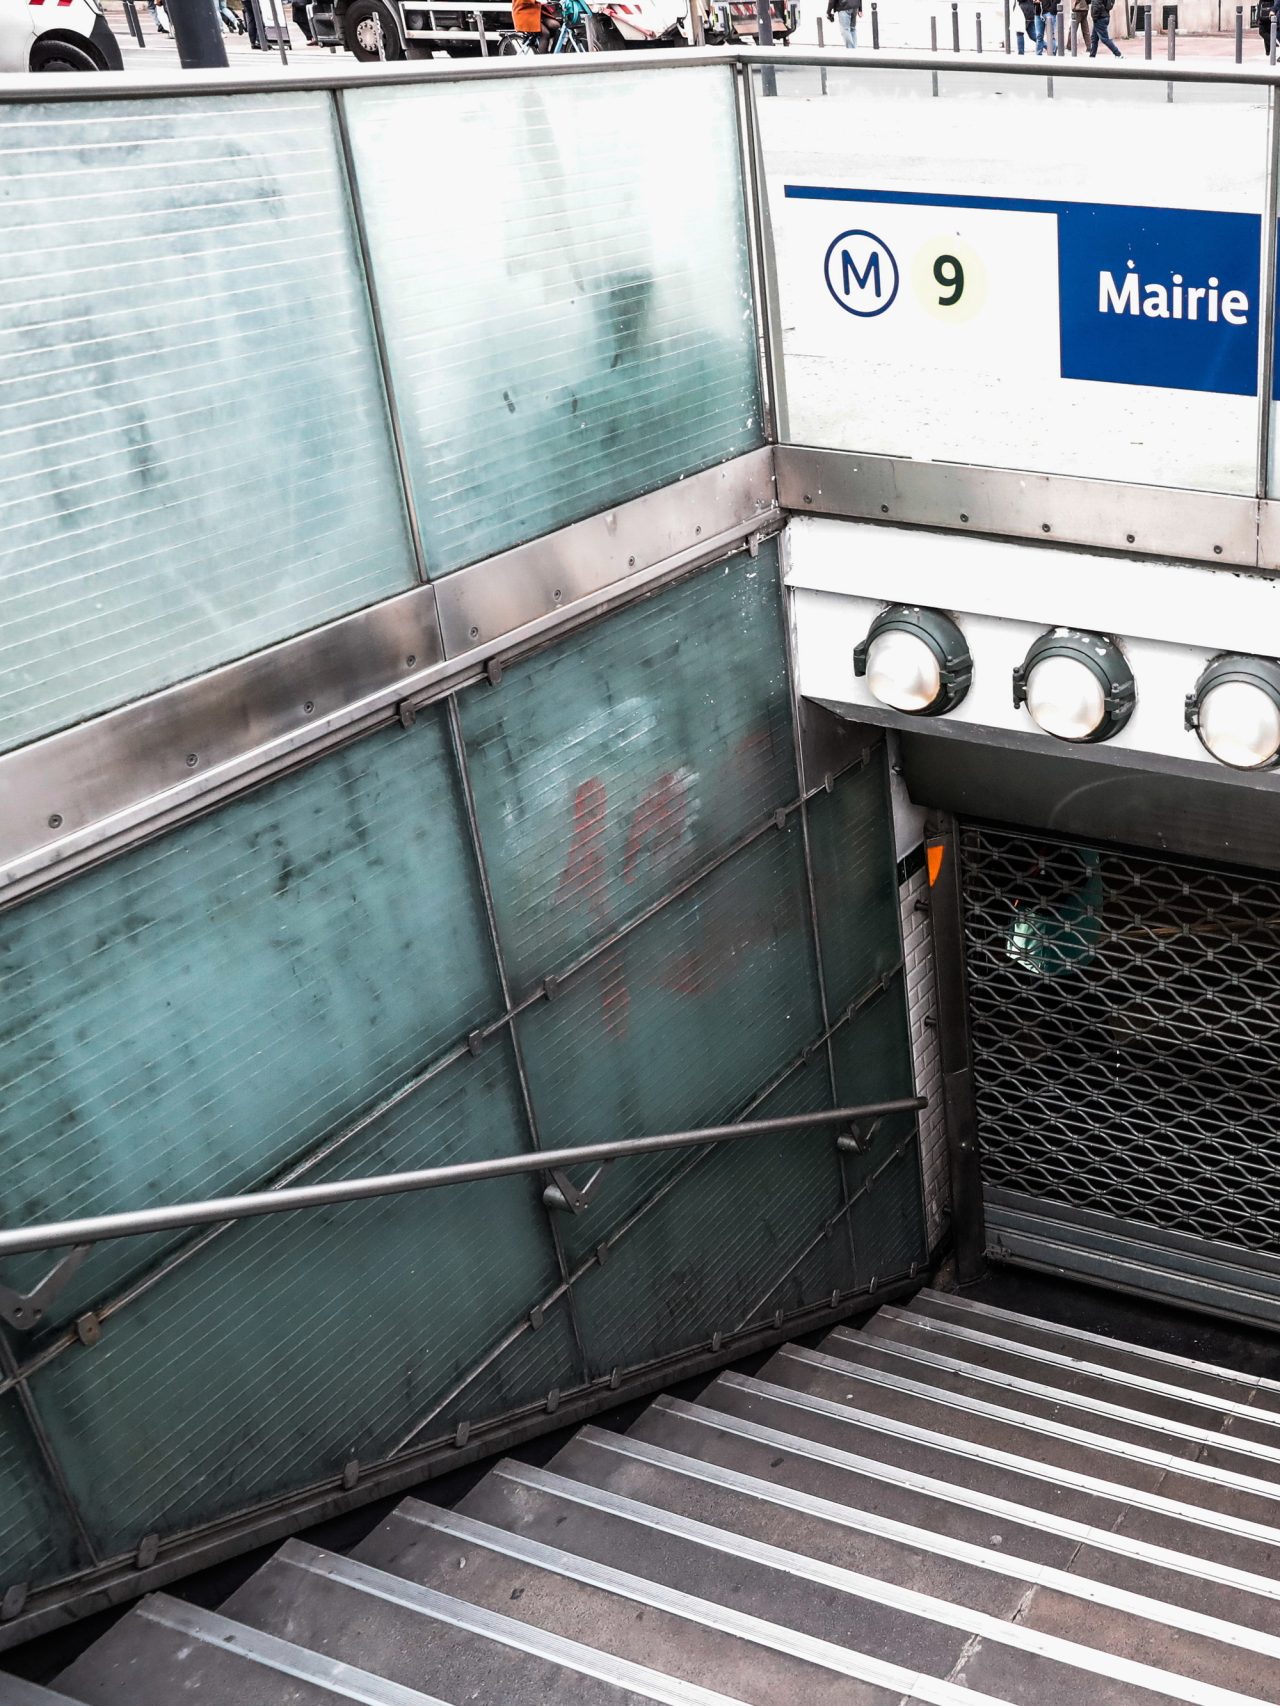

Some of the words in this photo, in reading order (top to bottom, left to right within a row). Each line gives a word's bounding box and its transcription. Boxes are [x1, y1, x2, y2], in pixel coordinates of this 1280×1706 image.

[841, 249, 882, 298] M
[933, 254, 965, 307] 9
[1098, 270, 1249, 325] Mairie
